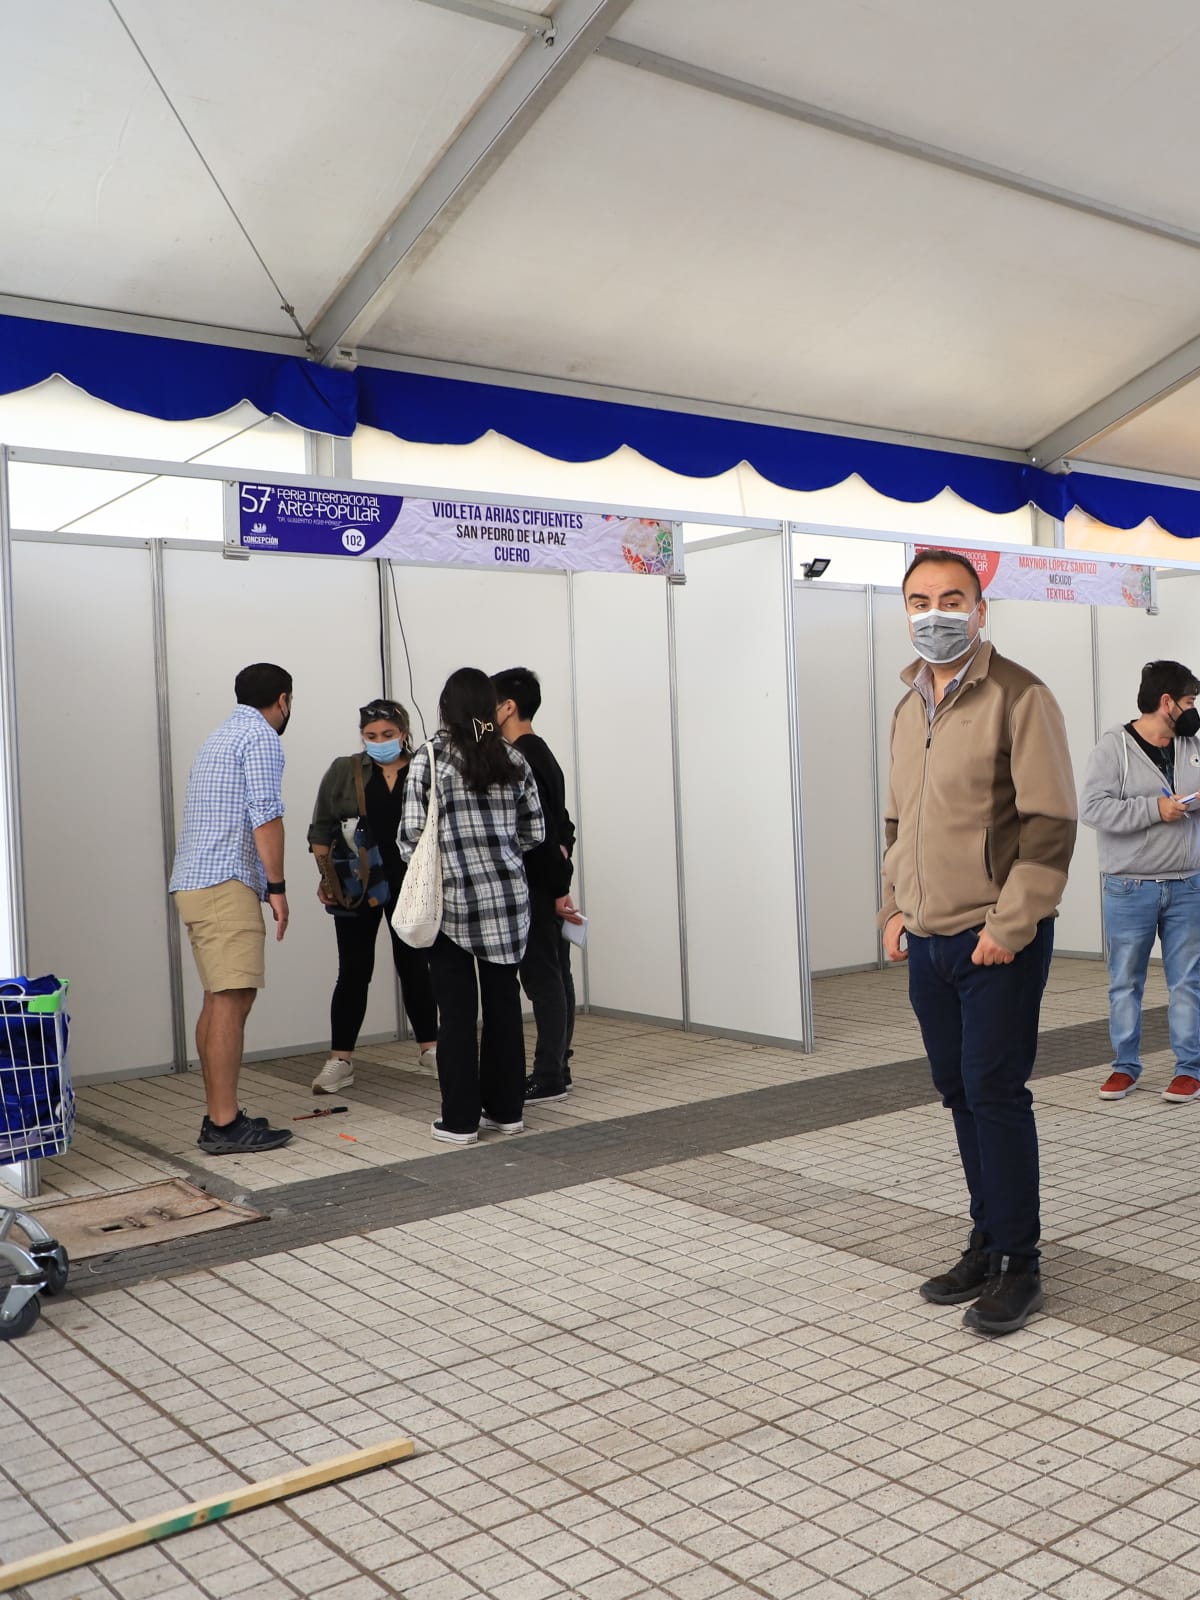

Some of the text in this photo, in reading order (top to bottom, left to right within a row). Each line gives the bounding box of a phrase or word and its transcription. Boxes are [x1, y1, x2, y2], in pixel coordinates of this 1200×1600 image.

[432, 501, 583, 529] VIOLETA ARIAS CIFUENTES
[243, 535, 279, 546] CONCEPCIÓN
[345, 535, 361, 547] 102
[456, 524, 566, 546] SAN PEDRO DE LA PAZ
[494, 546, 530, 563] CUERO
[1019, 556, 1097, 575] MAYNOR LÓPEZ SANTIZO
[1049, 573, 1072, 586] MÉXICO
[1046, 588, 1075, 601] TEXTILES
